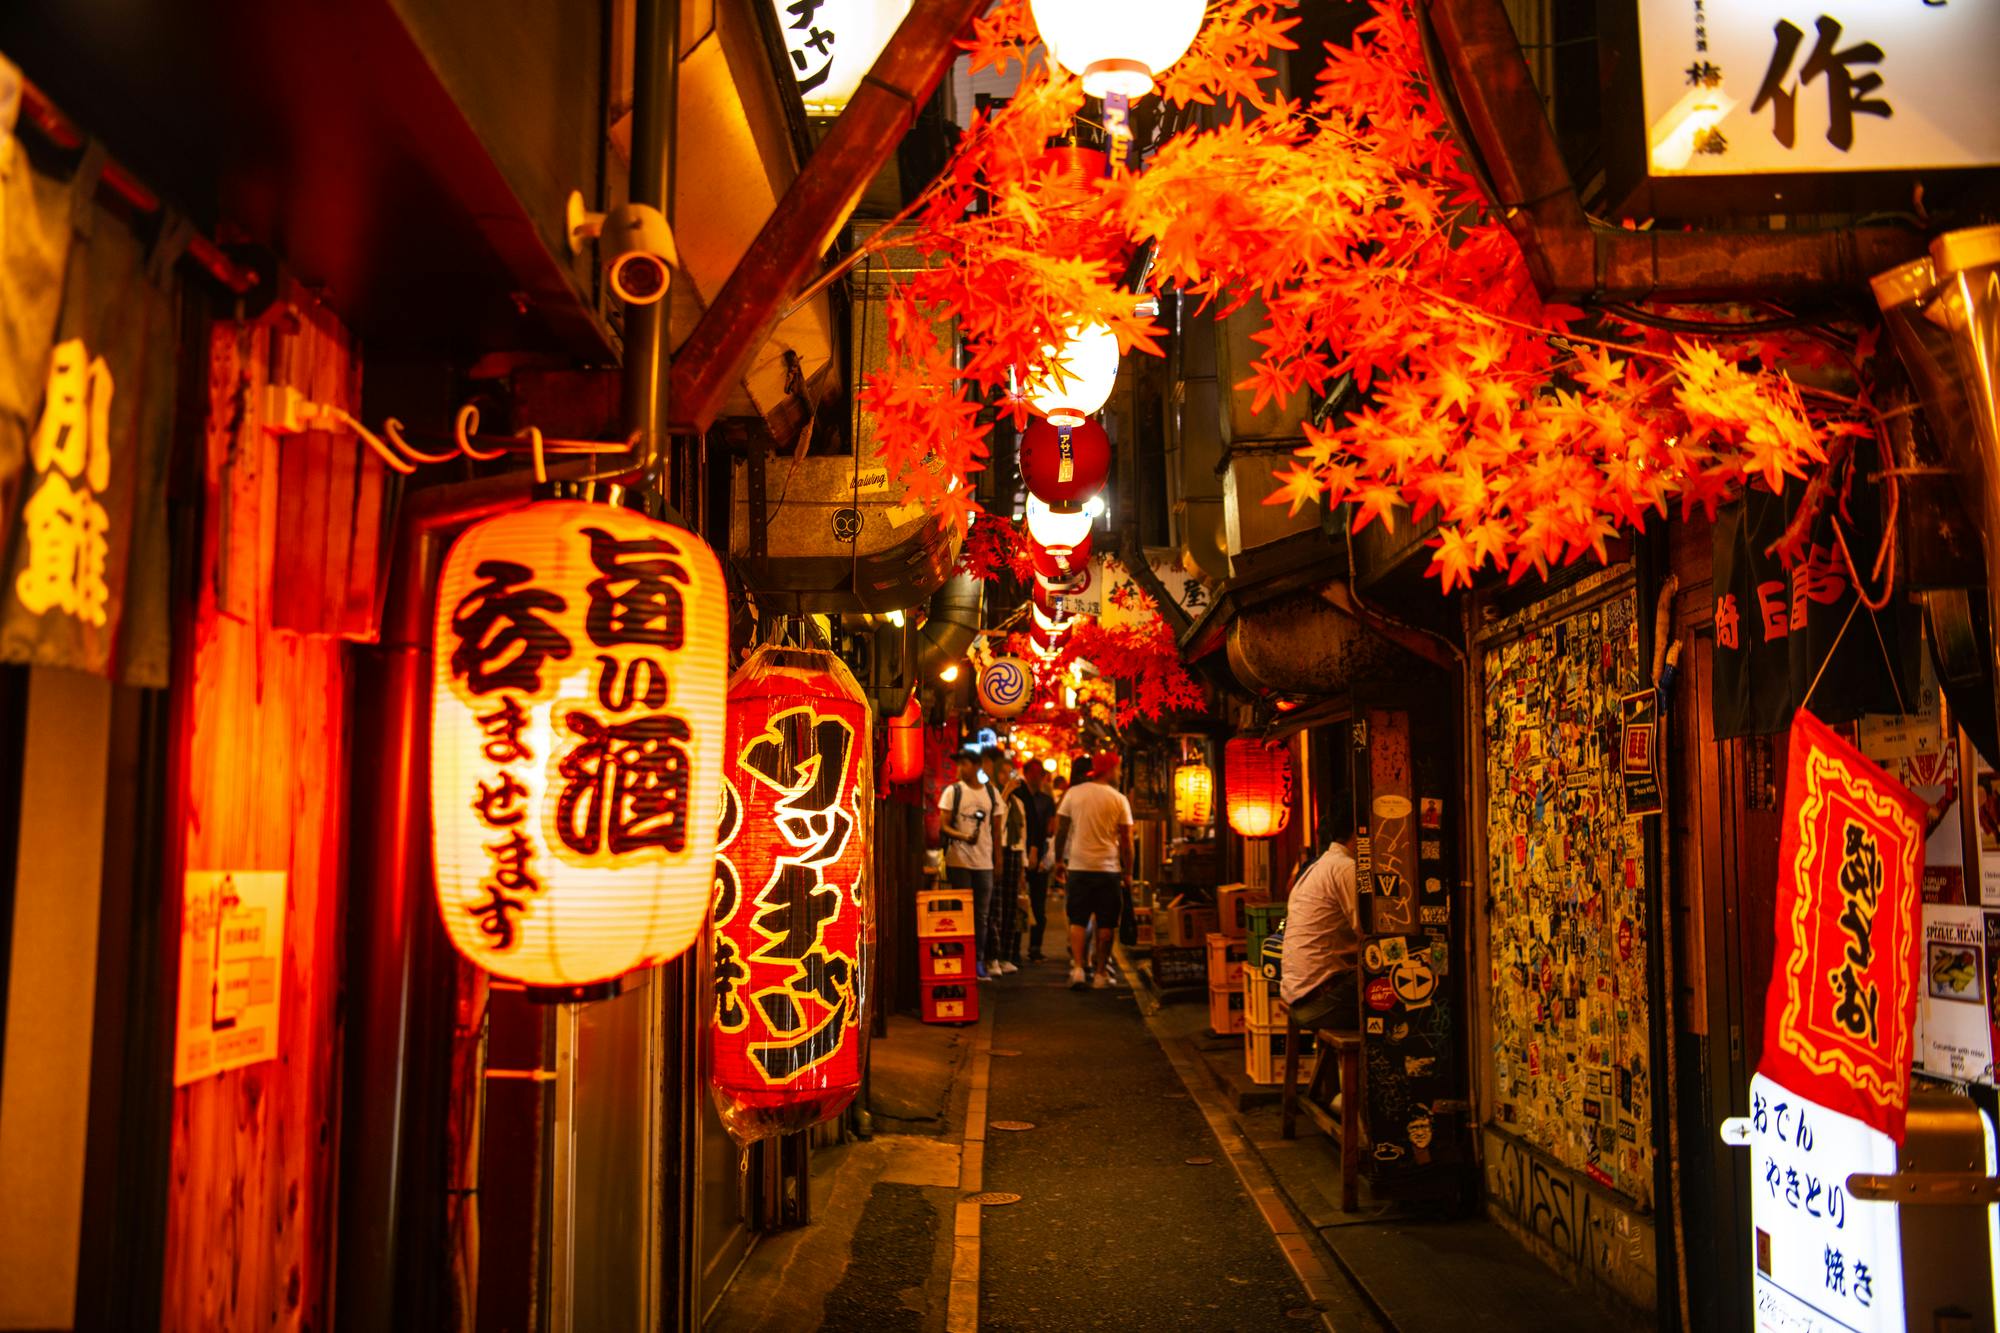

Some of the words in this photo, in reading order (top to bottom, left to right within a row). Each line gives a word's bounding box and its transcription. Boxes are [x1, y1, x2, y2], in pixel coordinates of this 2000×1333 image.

[1750, 14, 1894, 153] 作
[451, 560, 572, 949] 呑ませます
[557, 526, 692, 856] 旨い酒
[738, 705, 855, 1086] ウッチャン
[1753, 1093, 1814, 1152] おでん
[1765, 1156, 1846, 1229] やきとり
[1824, 1243, 1874, 1308] 焼き
